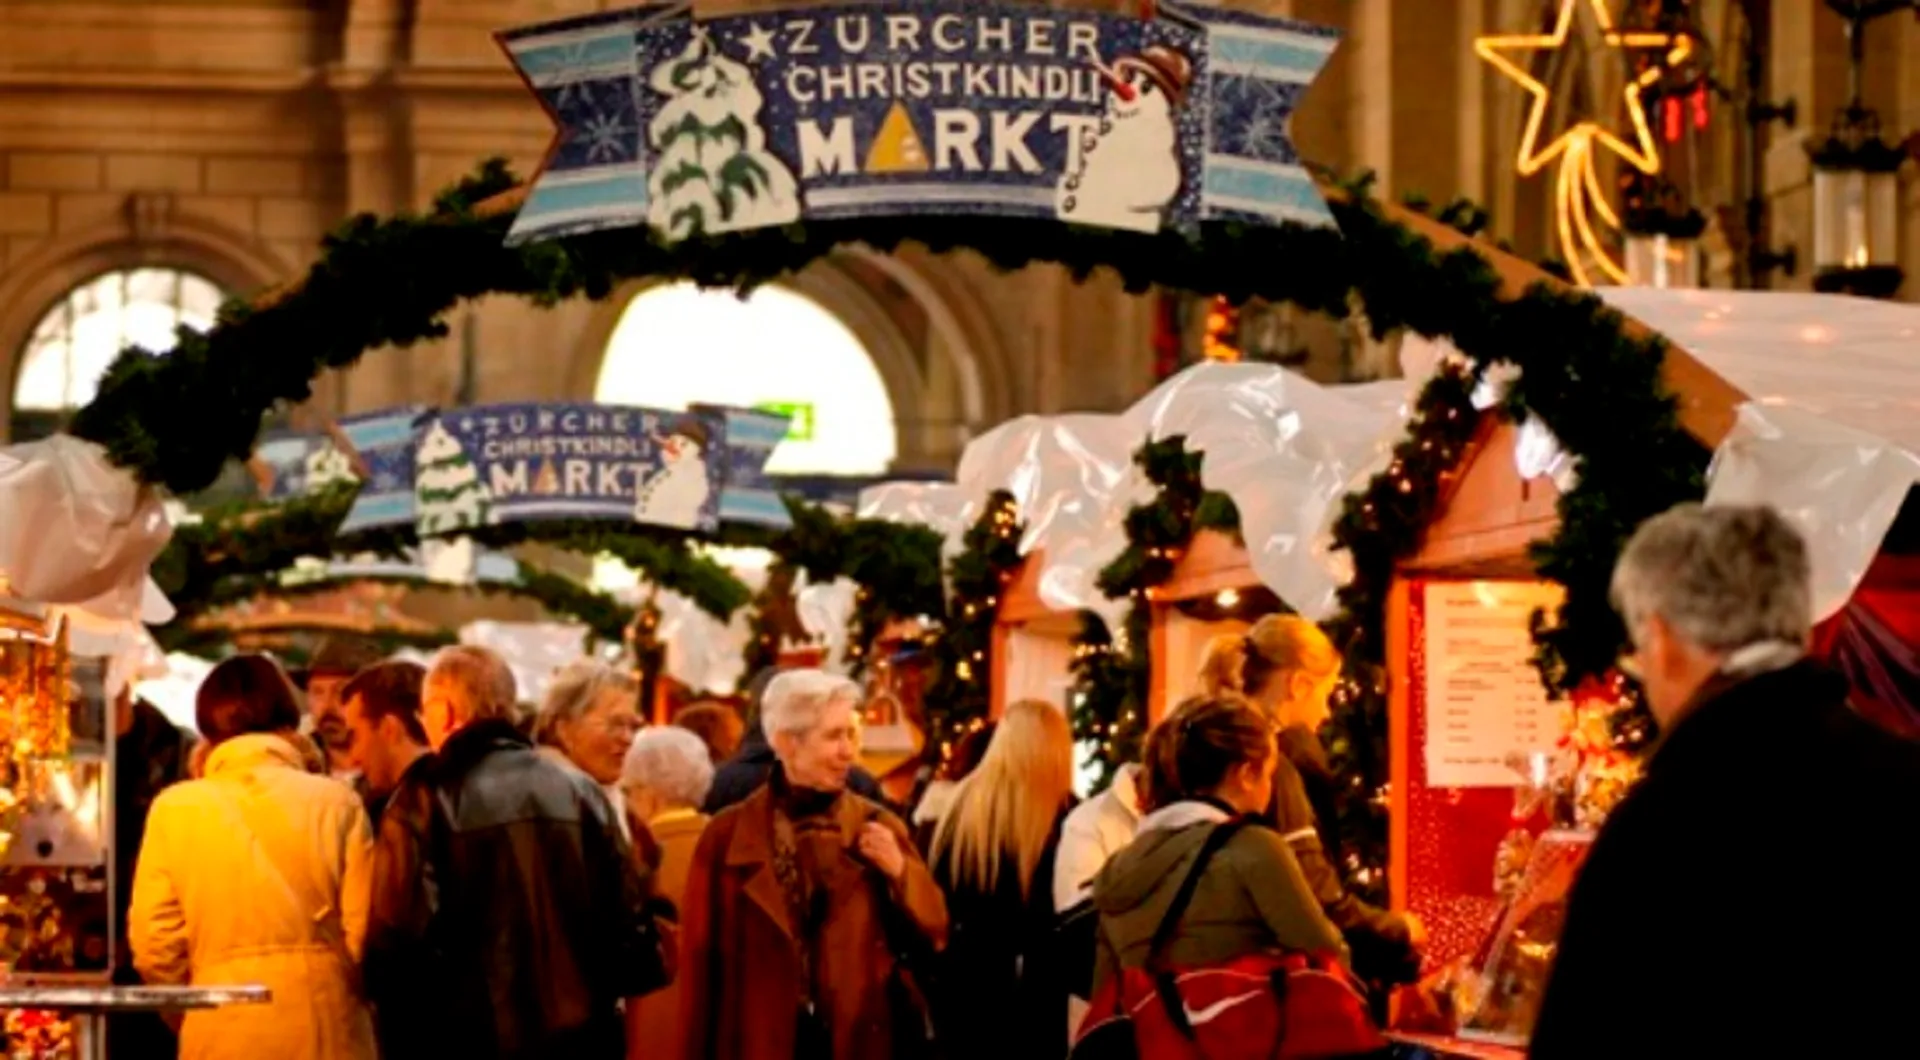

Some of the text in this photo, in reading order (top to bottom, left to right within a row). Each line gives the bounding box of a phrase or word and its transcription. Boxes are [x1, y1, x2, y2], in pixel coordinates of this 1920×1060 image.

[785, 14, 1099, 59] ZÜRCHER
[786, 61, 1099, 104] CHRISTKINDLI
[796, 99, 1100, 179] MARKT
[484, 434, 651, 459] CHRISTKINDLI
[489, 456, 653, 498] MARKT
